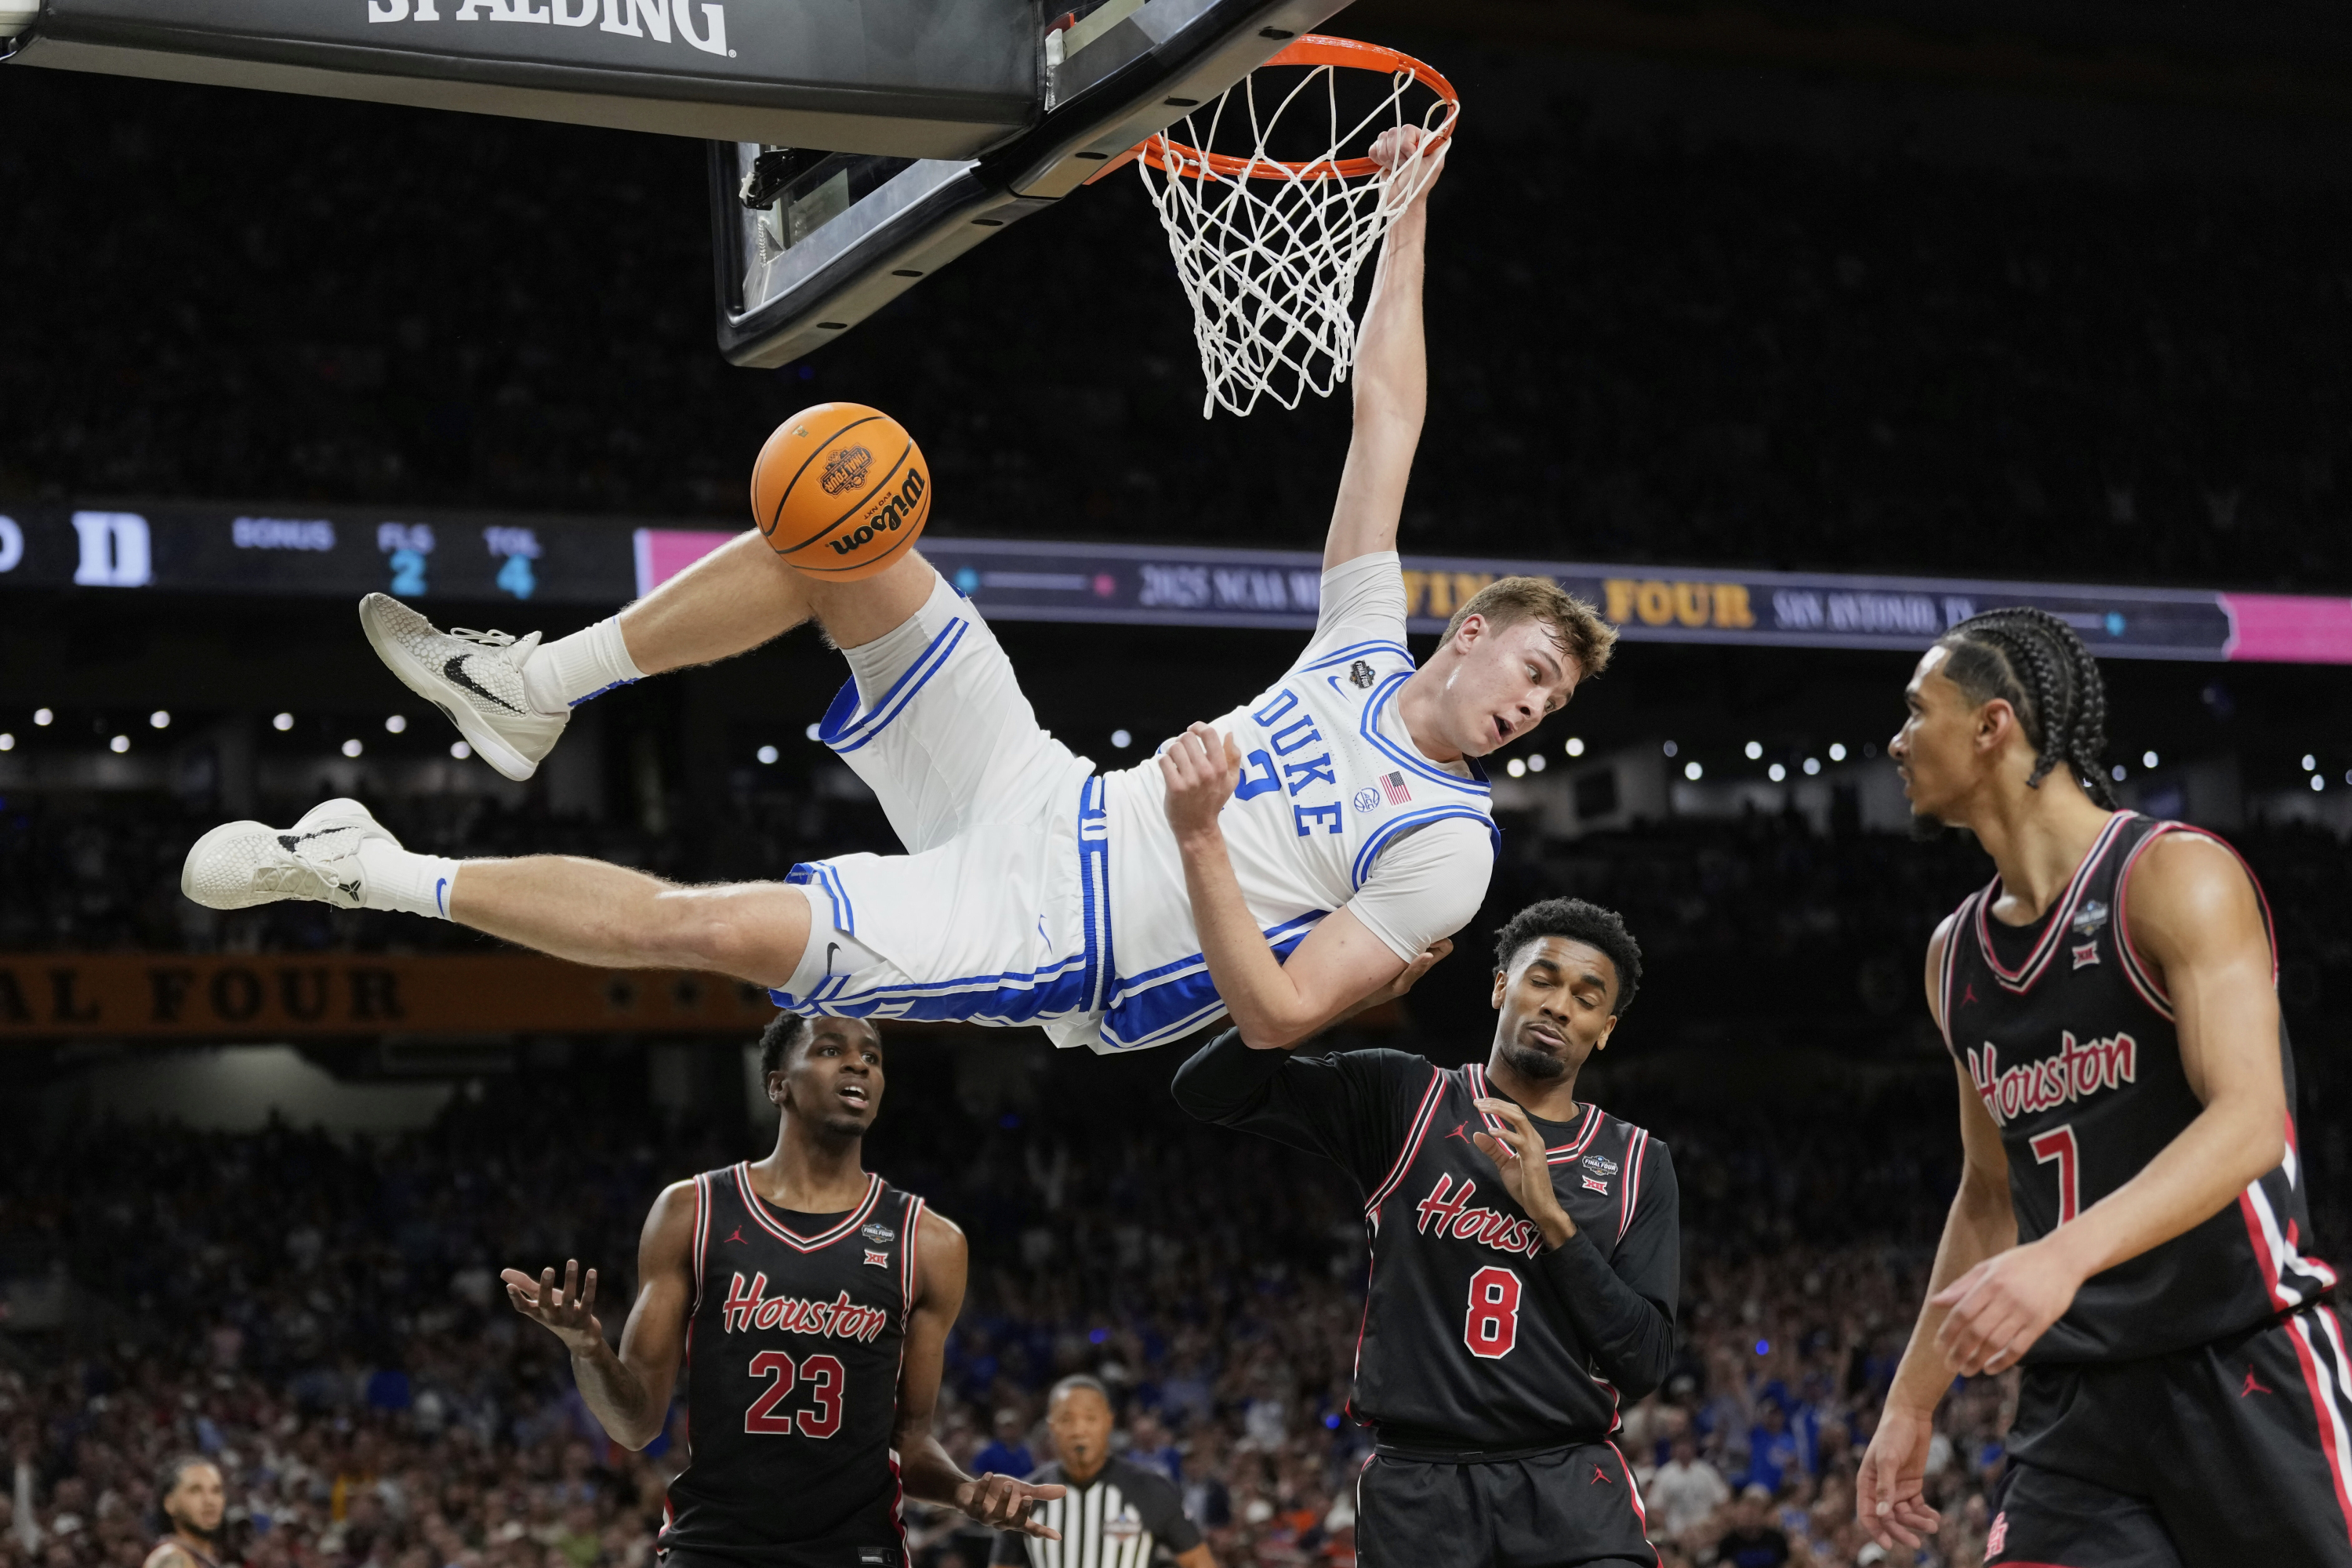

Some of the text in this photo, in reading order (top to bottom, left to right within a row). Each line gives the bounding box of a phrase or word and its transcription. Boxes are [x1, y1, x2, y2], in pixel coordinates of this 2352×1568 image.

[232, 517, 336, 550] BONUS
[829, 468, 925, 555] Wilson
[390, 550, 427, 597] 2
[497, 554, 535, 599] 4
[1604, 579, 1755, 628] FOUR
[1251, 688, 1342, 837] DUKE
[147, 967, 407, 1022] FOUR
[1966, 1029, 2136, 1127] Houston
[1584, 1159, 1616, 1171] FINAL FOUR
[2028, 1123, 2080, 1229] 7
[723, 1271, 886, 1343] Houston
[1464, 1265, 1523, 1359] 8
[745, 1350, 844, 1439] 23
